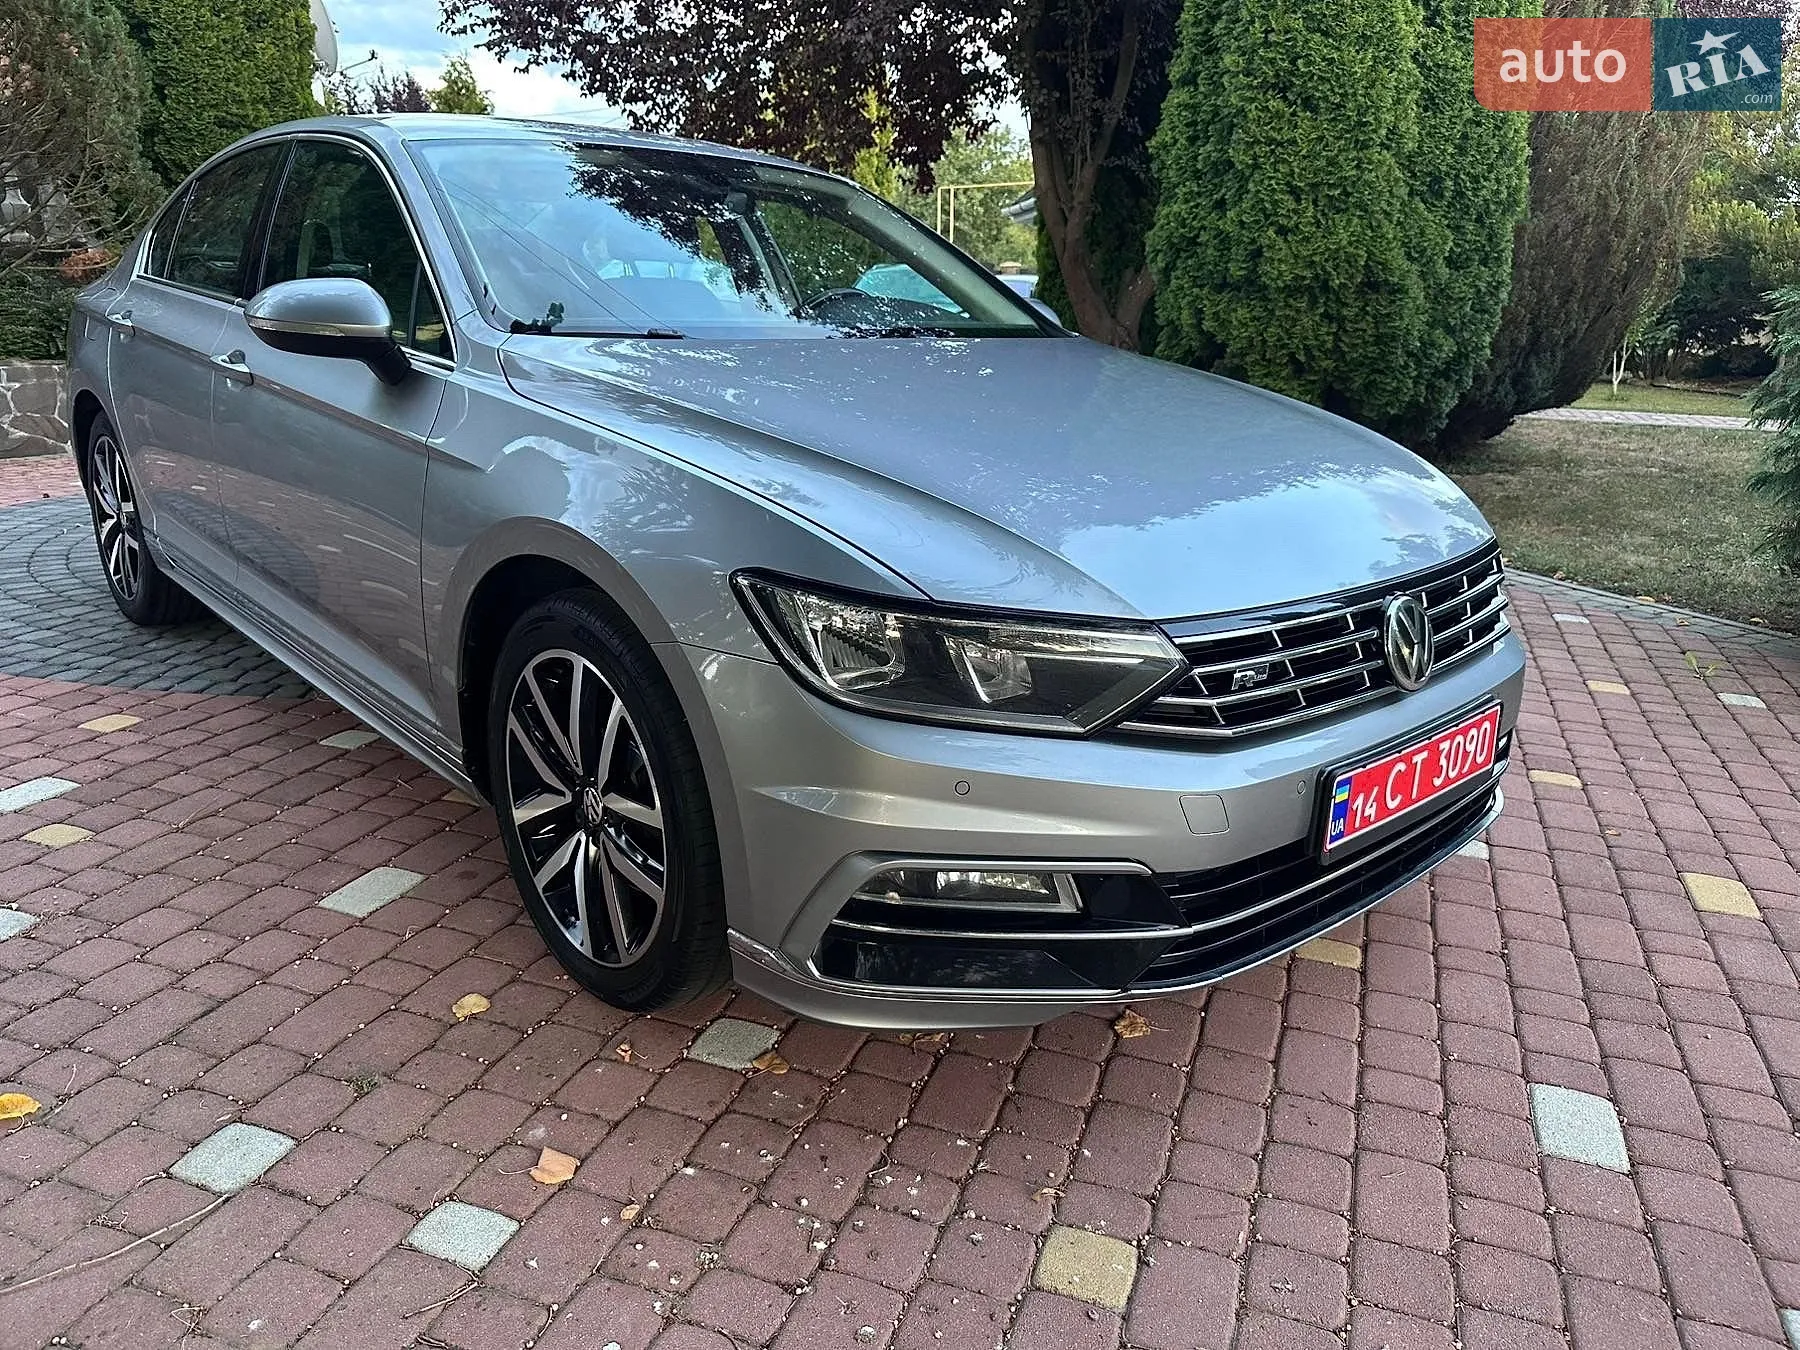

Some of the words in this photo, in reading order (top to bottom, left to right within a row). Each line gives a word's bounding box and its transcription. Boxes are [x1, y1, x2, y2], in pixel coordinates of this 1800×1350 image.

[1351, 785, 1379, 829] 14
[1385, 749, 1429, 810] CT
[1431, 719, 1491, 788] 3090
[1330, 817, 1344, 836] UA
